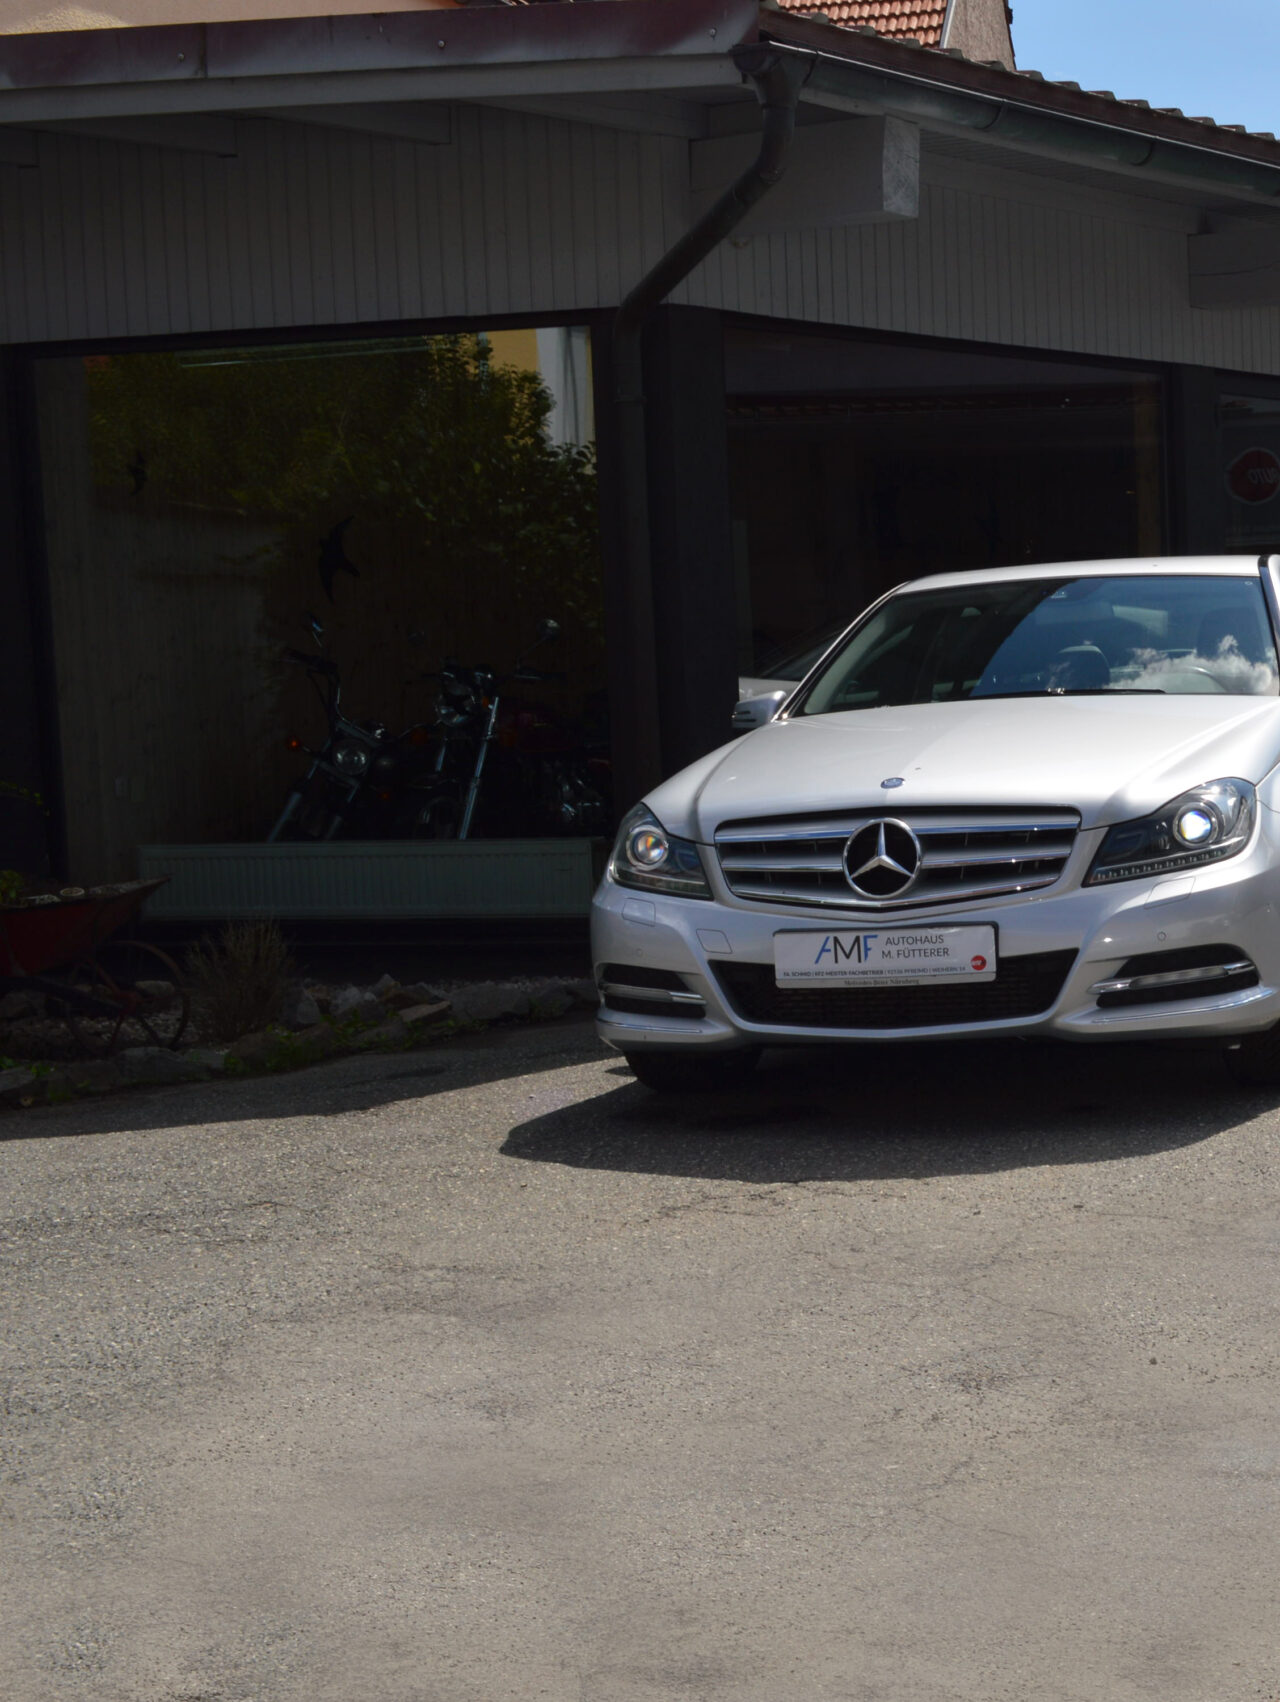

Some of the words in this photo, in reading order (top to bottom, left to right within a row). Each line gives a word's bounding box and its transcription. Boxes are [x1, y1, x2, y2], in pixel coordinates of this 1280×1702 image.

[885, 934, 945, 947] AUTOHAUS
[814, 934, 879, 964] AMF
[881, 949, 894, 960] M.
[897, 947, 950, 959] FÜTTERER
